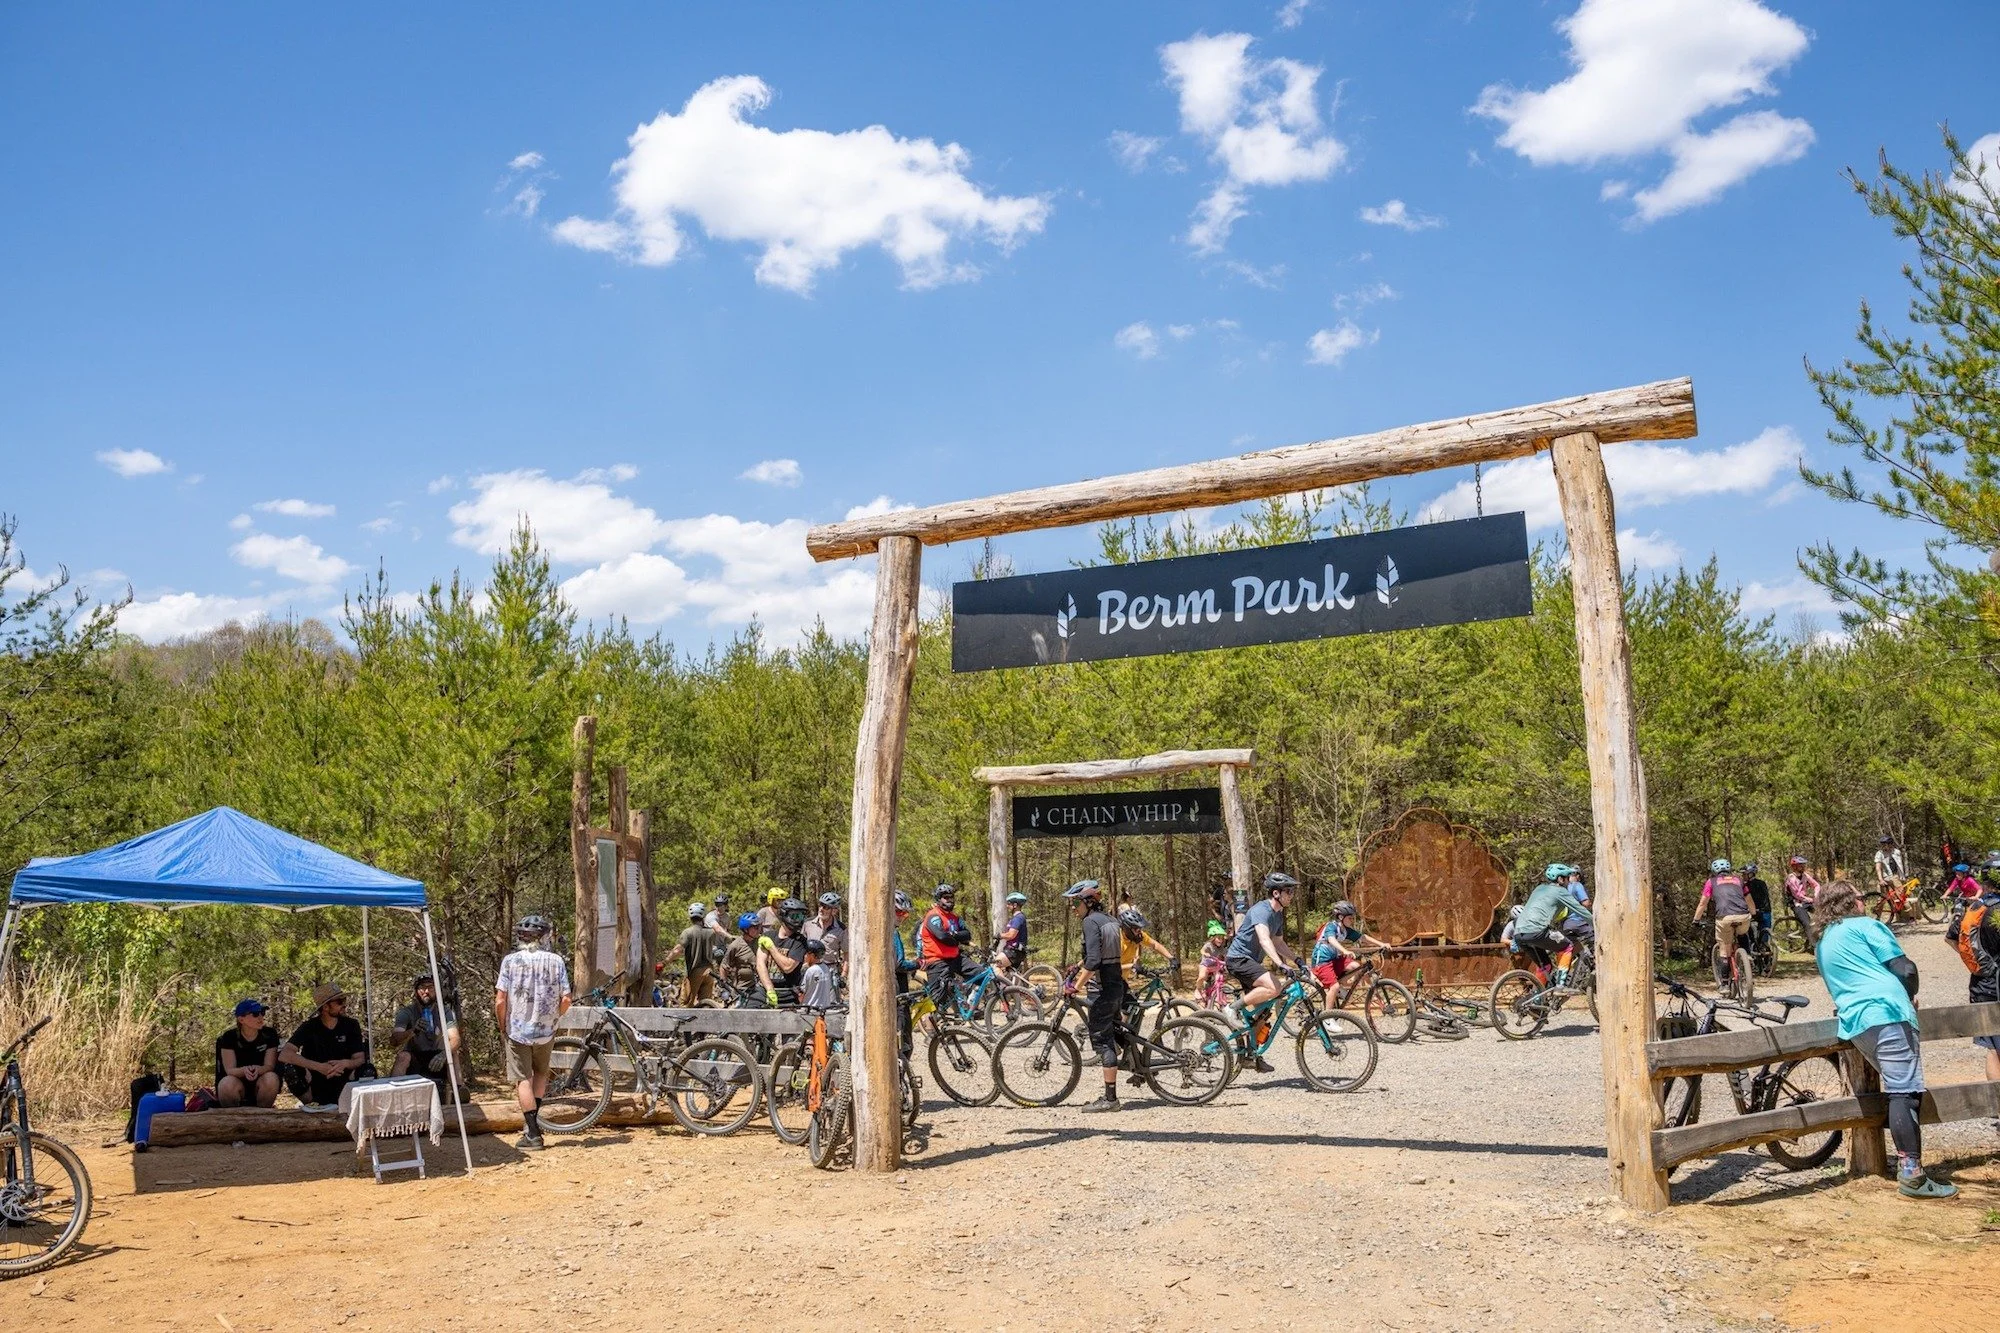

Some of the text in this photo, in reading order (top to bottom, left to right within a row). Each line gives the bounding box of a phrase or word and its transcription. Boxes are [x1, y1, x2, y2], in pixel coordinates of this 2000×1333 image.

[1096, 563, 1356, 635] Berm Park
[1047, 803, 1183, 826] CHAIN WHIP
